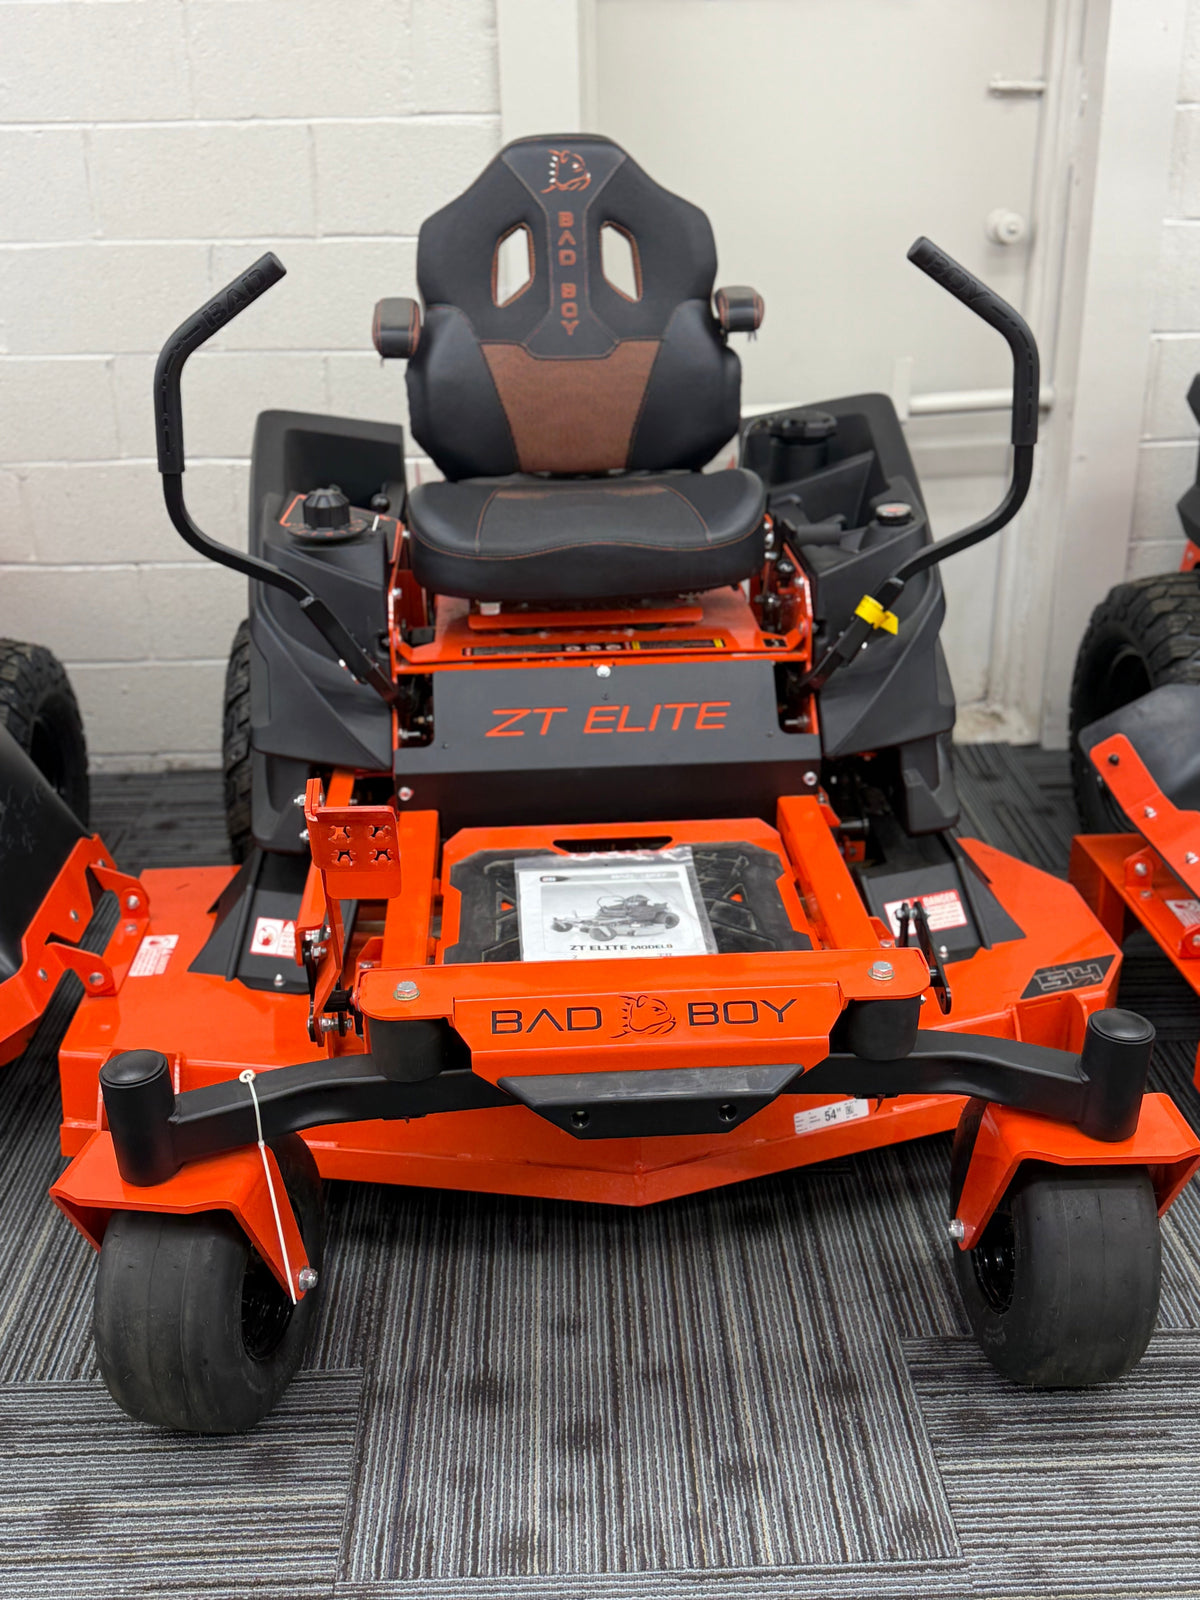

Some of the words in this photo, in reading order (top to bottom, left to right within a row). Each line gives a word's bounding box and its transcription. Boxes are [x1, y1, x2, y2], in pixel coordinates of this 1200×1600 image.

[558, 211, 576, 266] BAD
[560, 282, 579, 336] BOY
[485, 707, 569, 737] ZT
[583, 701, 731, 734] ELITE
[1033, 963, 1104, 992] 54
[491, 1007, 602, 1034] BAD
[688, 998, 797, 1026] BOY
